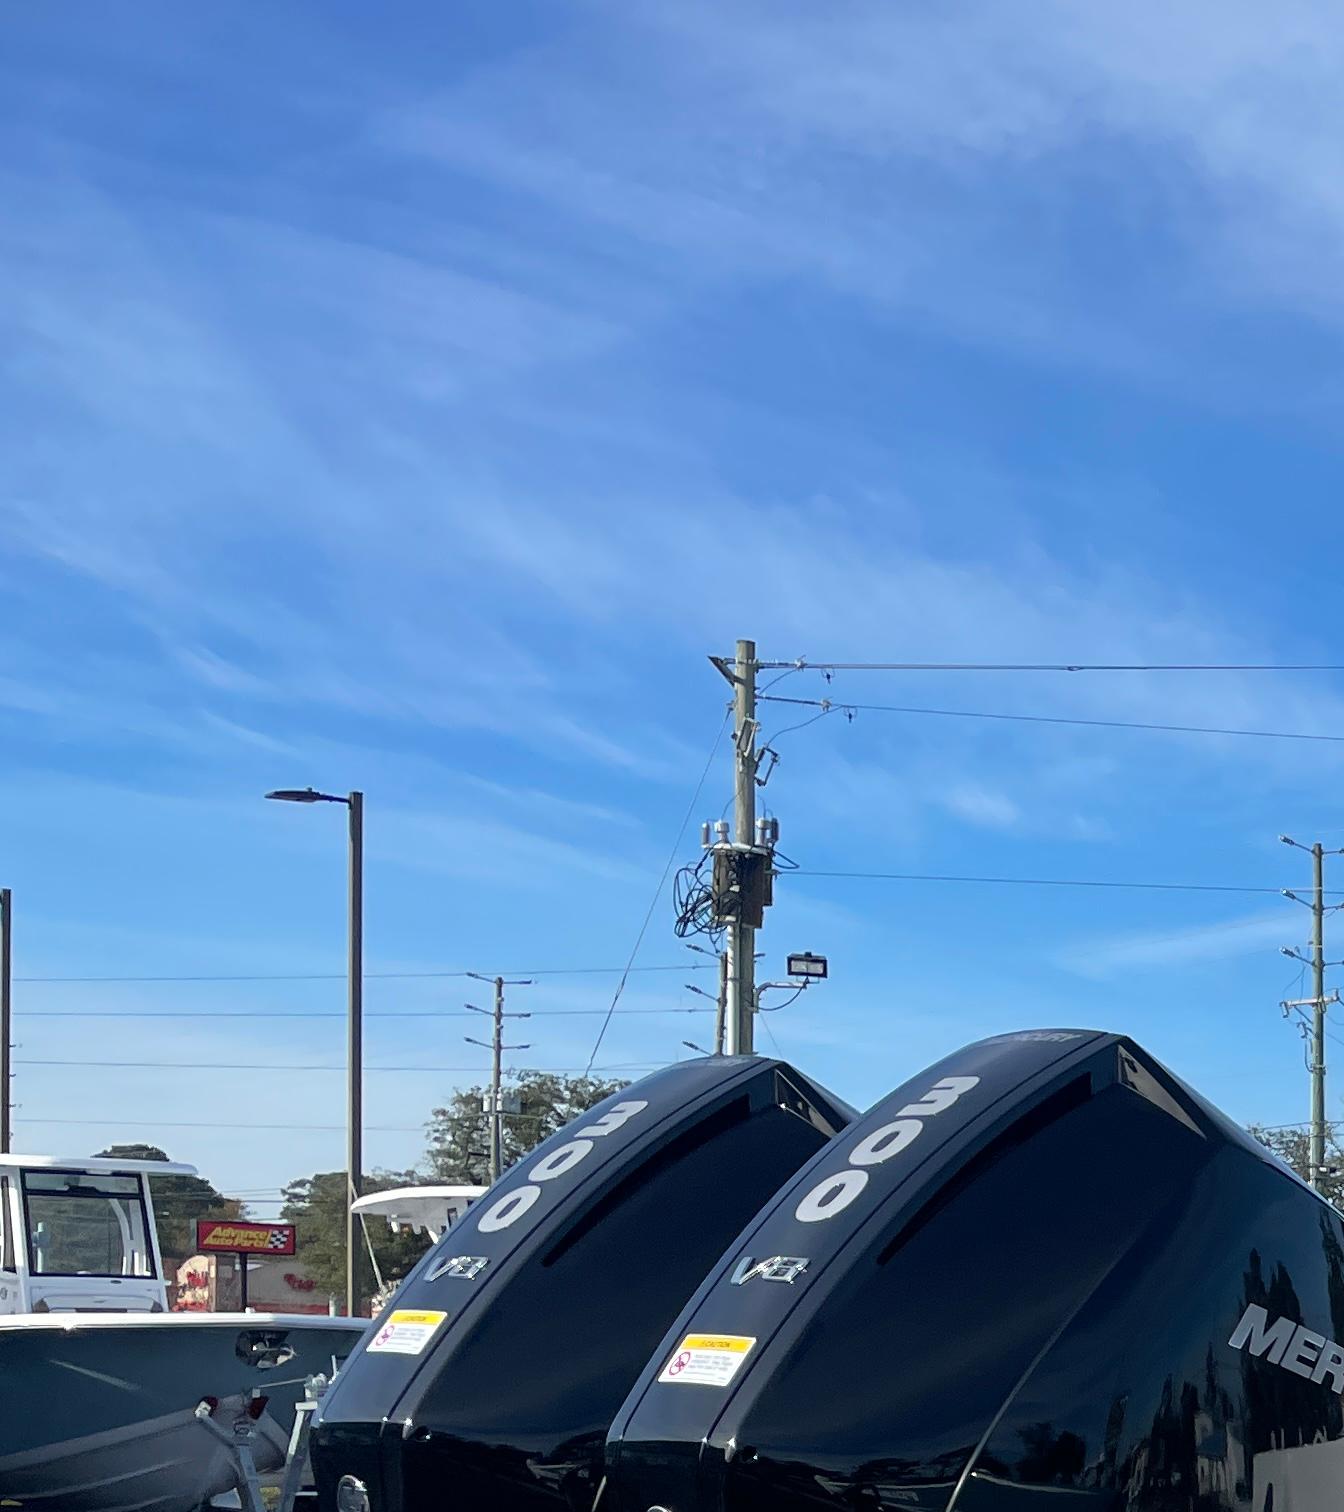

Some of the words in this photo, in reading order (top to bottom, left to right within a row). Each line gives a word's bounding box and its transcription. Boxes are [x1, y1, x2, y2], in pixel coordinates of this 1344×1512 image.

[795, 1076, 981, 1222] 300
[477, 1101, 648, 1232] 300
[203, 1236, 233, 1246] Auto
[236, 1237, 266, 1248] Parts
[210, 1226, 267, 1239] Advance
[423, 1255, 490, 1282] V8
[730, 1256, 811, 1286] V8
